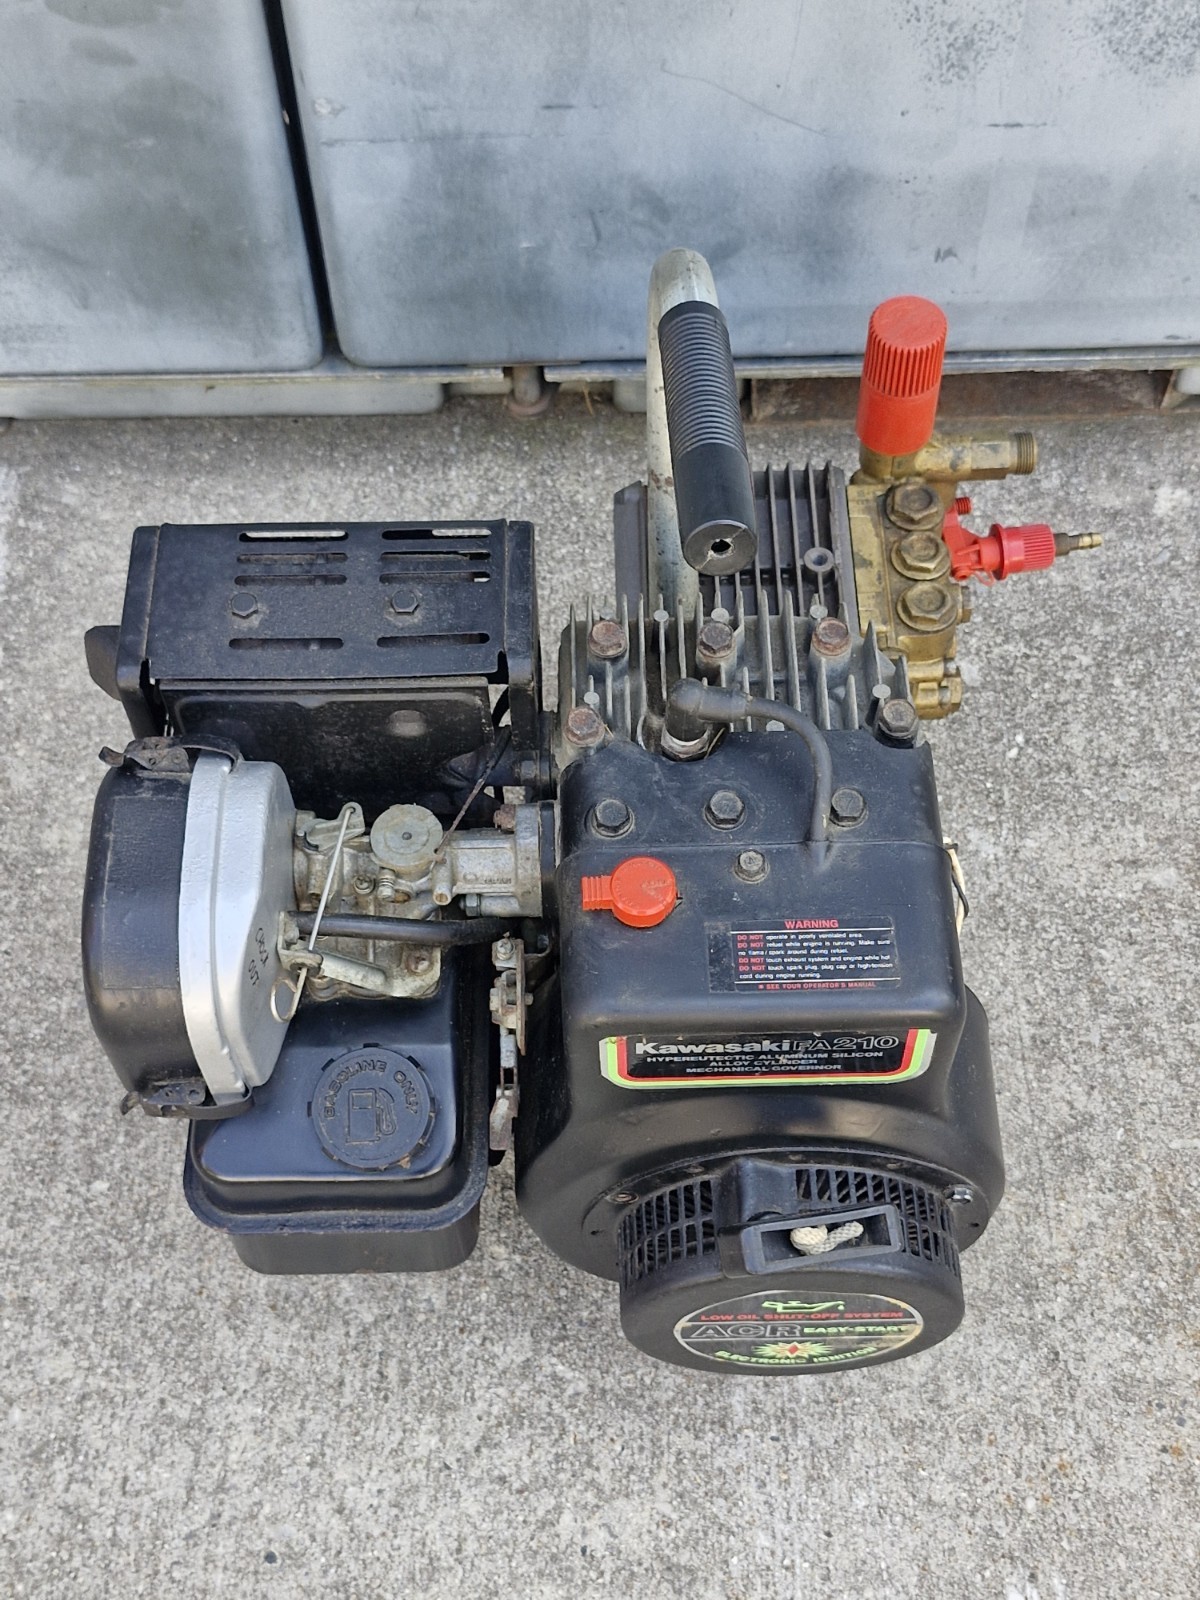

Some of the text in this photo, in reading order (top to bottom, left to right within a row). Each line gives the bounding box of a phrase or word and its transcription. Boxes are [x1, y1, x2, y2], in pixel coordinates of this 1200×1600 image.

[784, 919, 839, 929] WARNING
[635, 1036, 899, 1055] Kawasaki FA210
[753, 1059, 818, 1067] CYLINDER
[772, 1064, 842, 1072] GOVERNOR
[393, 1071, 419, 1114] ONLY
[763, 1312, 840, 1320] SHUT-OFF
[691, 1324, 801, 1337] ACR
[715, 1347, 878, 1364] ELECTRONIC IGNITION
